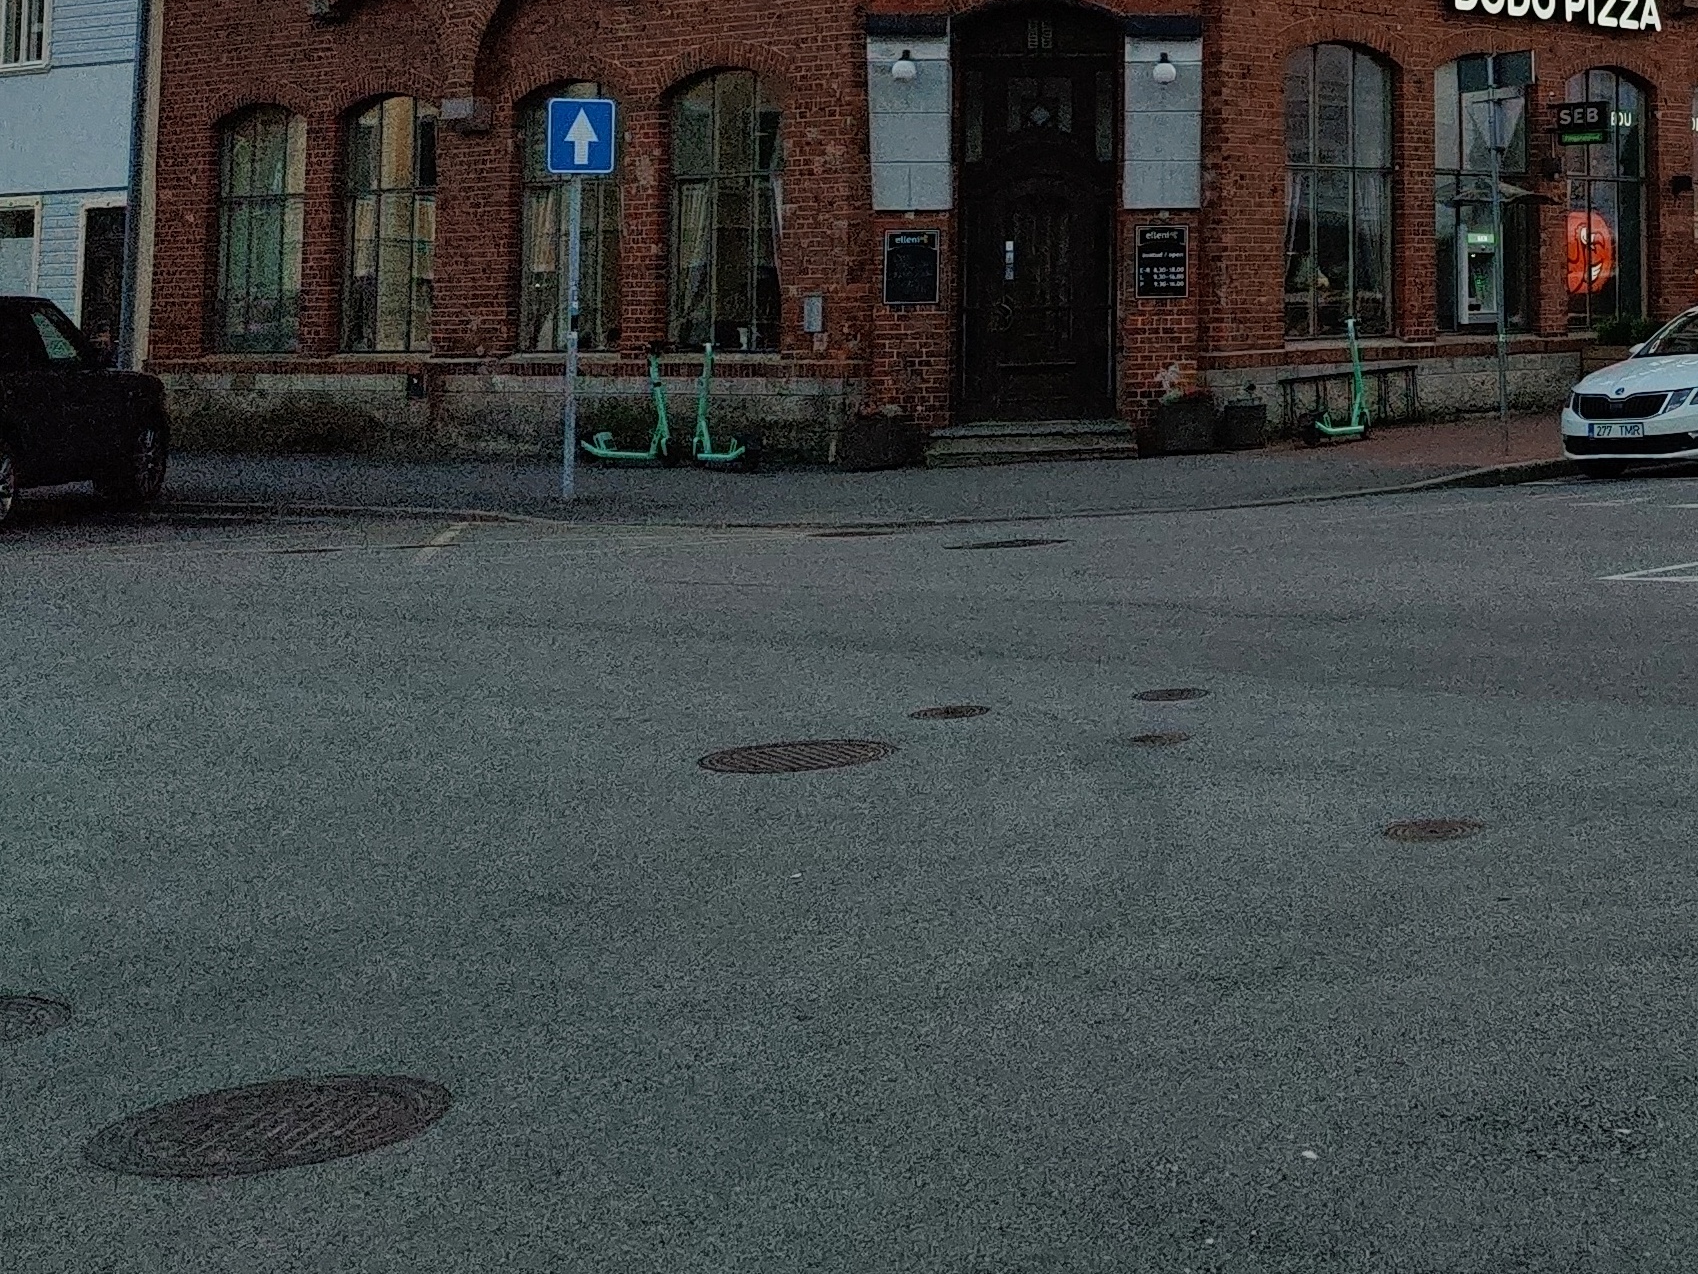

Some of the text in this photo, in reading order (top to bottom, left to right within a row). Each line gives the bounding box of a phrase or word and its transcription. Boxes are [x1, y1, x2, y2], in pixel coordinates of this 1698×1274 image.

[1559, 107, 1599, 125] SEB
[1596, 424, 1641, 437] 277 TMR
